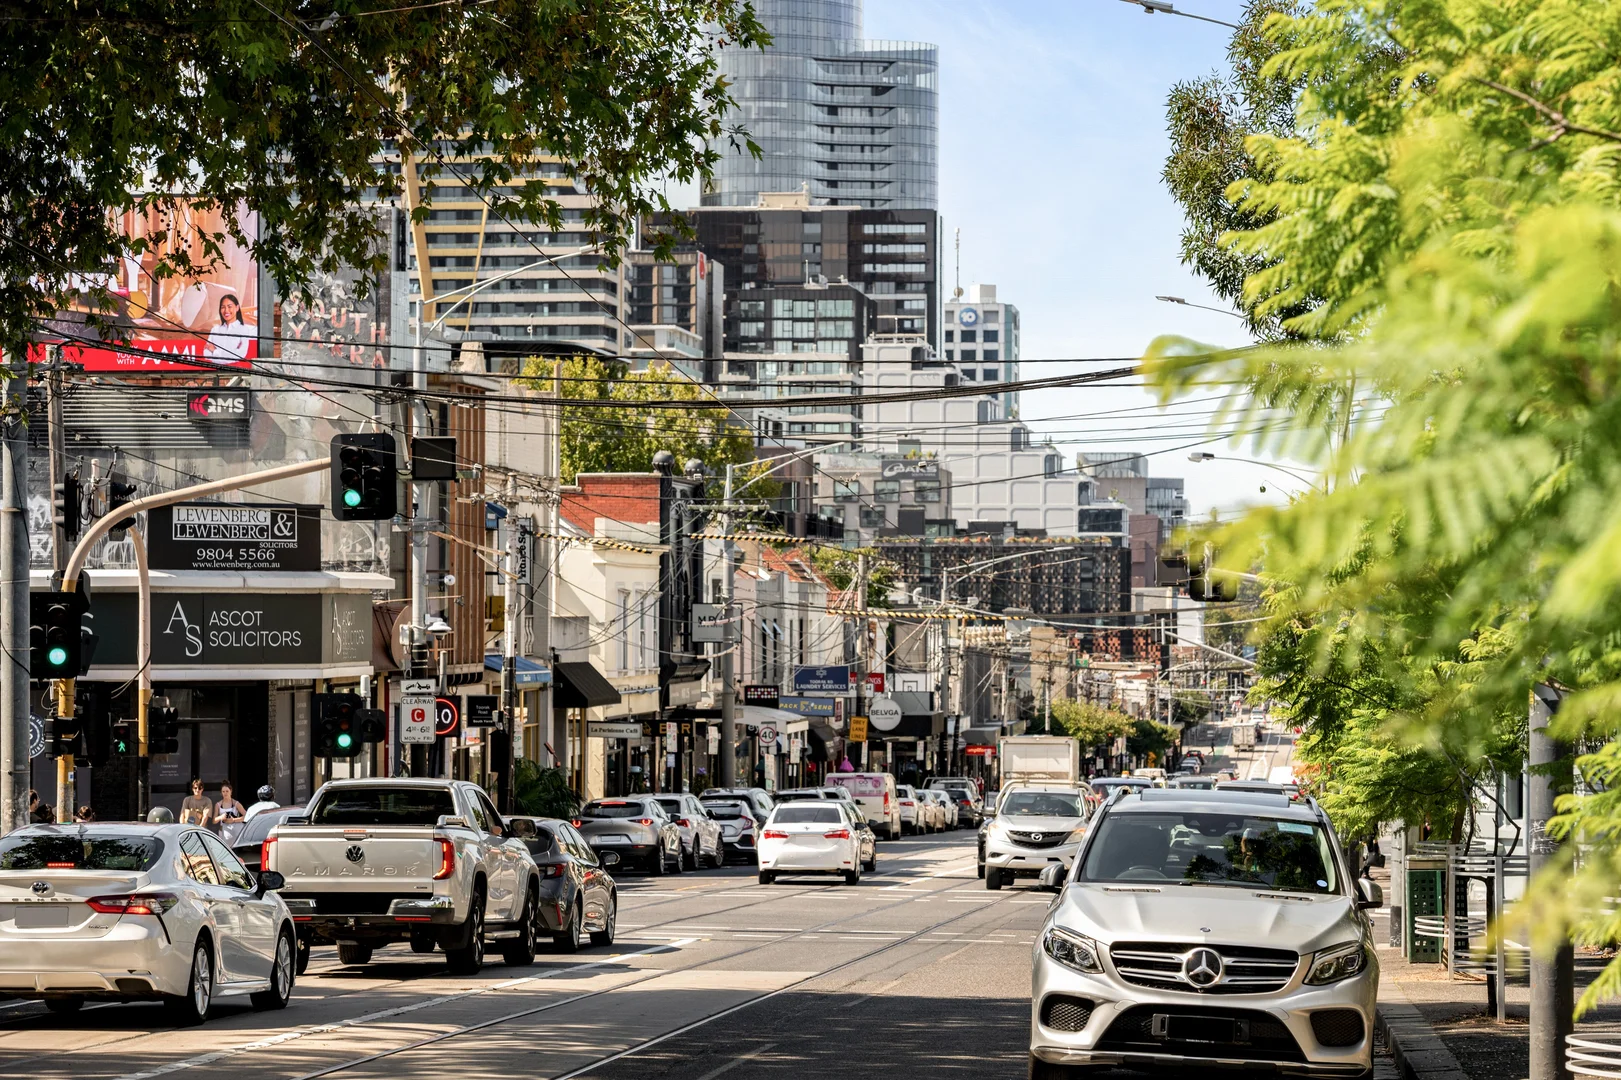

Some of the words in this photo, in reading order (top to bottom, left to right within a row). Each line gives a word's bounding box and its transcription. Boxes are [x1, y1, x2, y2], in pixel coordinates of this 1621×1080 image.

[961, 311, 977, 322] 10
[207, 398, 244, 414] QMS
[176, 508, 267, 523] LEWENBERG
[273, 513, 293, 536] &
[176, 524, 267, 540] LEWENBERG
[196, 548, 234, 560] 9804
[238, 548, 276, 560] 5566
[192, 560, 280, 570] www.lewenberg.com.au
[209, 610, 264, 626] ASCOT
[209, 630, 302, 647] SOLICITORS
[660, 723, 691, 734] BR
[762, 730, 774, 740] 40
[292, 866, 418, 876] AMAROK
